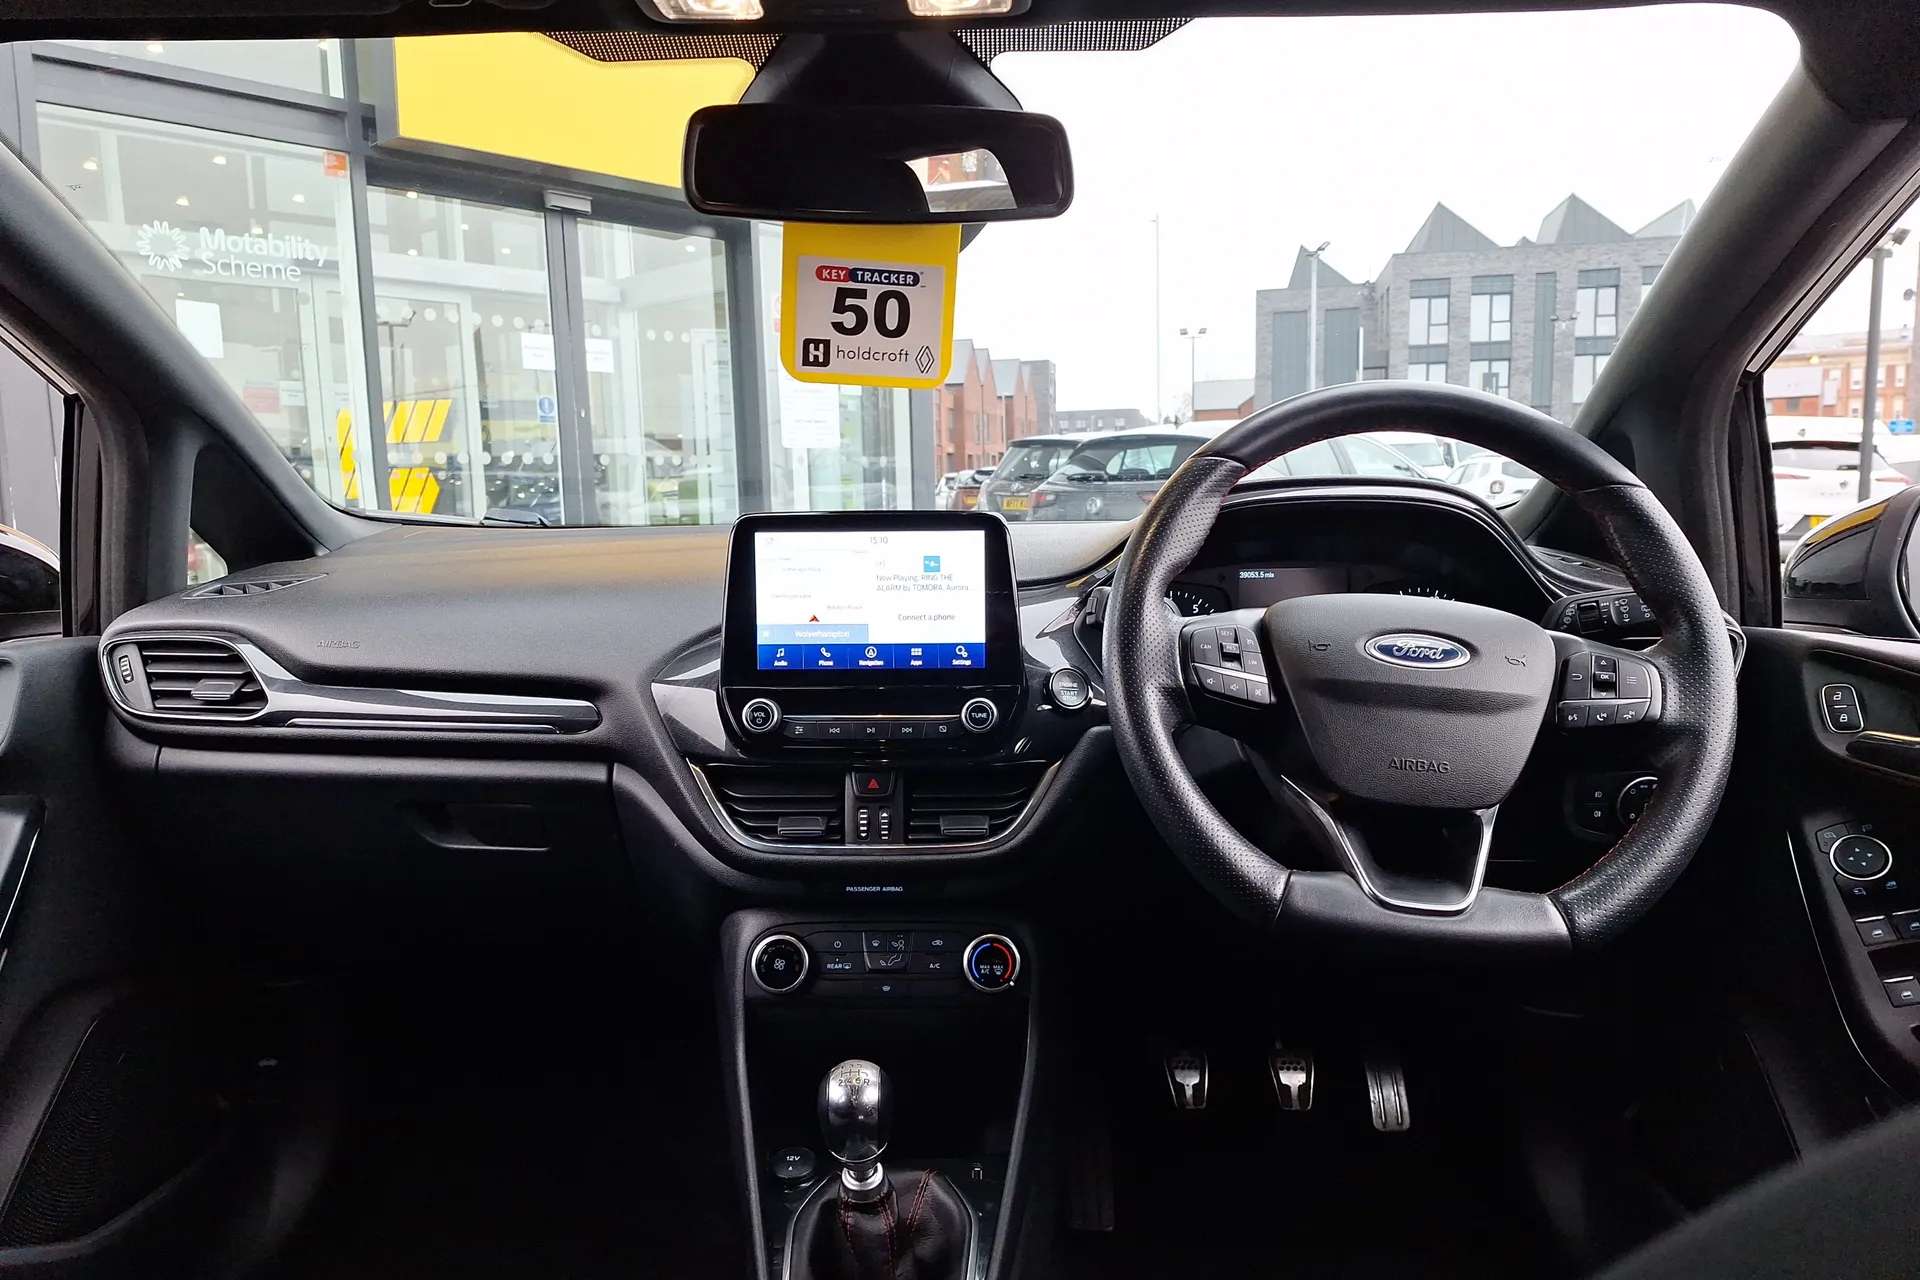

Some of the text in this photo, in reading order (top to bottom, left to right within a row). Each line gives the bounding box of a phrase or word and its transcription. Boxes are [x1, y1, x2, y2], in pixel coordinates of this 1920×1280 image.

[199, 226, 329, 268] Motability
[200, 248, 302, 282] Scheme
[822, 268, 914, 286] KEY TRACKER
[830, 286, 911, 339] 50
[836, 345, 910, 363] holdcroft
[897, 613, 927, 622] Connect
[933, 613, 956, 622] phone
[1192, 604, 1199, 614] 5
[316, 639, 361, 650] AIRBAG
[1391, 640, 1445, 661] Ford
[1388, 757, 1450, 774] AIRBAG
